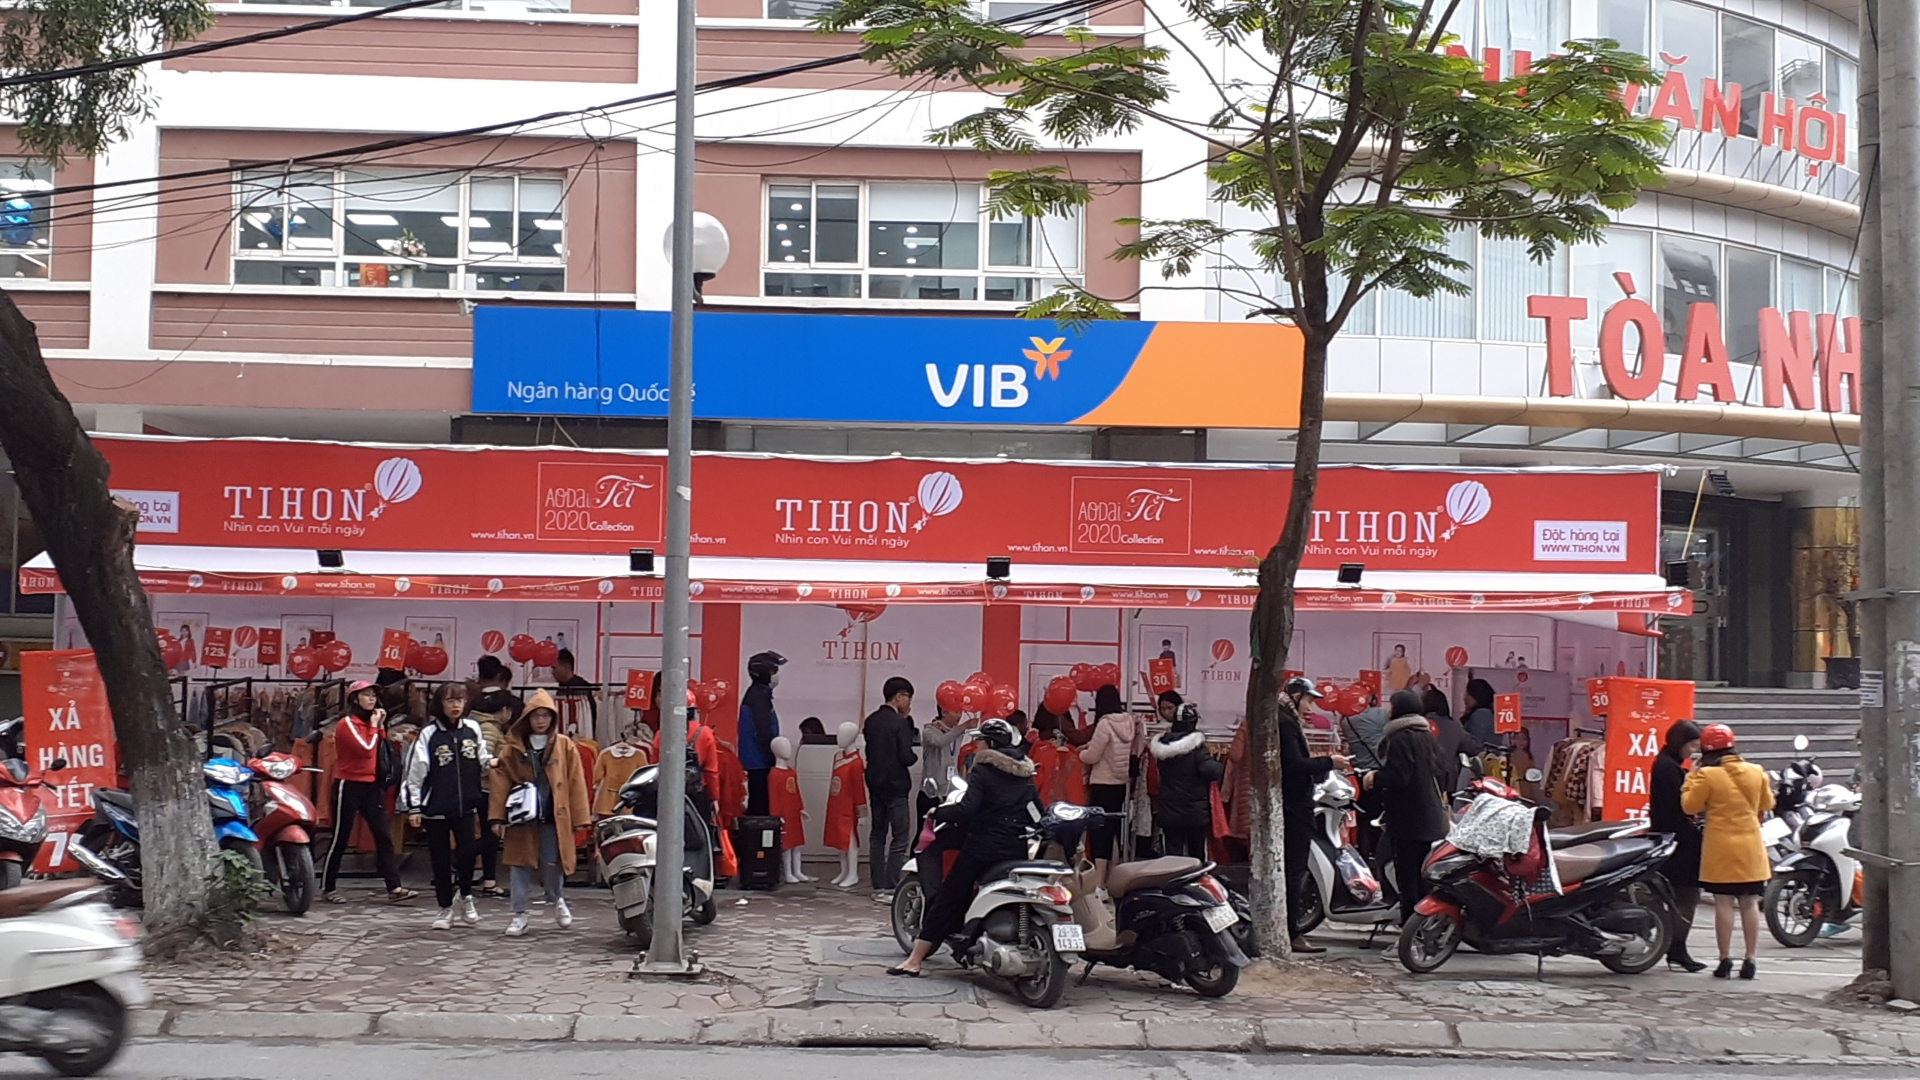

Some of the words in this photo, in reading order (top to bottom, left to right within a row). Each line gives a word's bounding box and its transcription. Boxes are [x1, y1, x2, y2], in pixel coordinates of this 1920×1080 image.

[1760, 91, 1848, 178] HỘI
[1526, 271, 1738, 403] TÒA
[508, 381, 558, 403] Ngân
[565, 381, 613, 405] hàng
[618, 382, 670, 403] Quốc
[924, 362, 1029, 410] VIB
[223, 485, 367, 522] TIHON
[544, 509, 590, 531] 2020
[589, 521, 635, 533] Collection
[775, 498, 911, 534] TIHON
[256, 525, 280, 533] con
[283, 522, 304, 534] Vui
[471, 529, 535, 540] www.tihon.vn
[1077, 523, 1121, 544] 2020
[1120, 533, 1164, 545] Collection
[1310, 510, 1439, 544] TIHON
[775, 533, 803, 544] Nhìn
[806, 536, 829, 545] con
[832, 534, 851, 545] Vui
[1570, 528, 1599, 544] hàng
[1602, 529, 1620, 544] tại
[1007, 542, 1068, 553] www.tihon.vn
[1194, 544, 1255, 556] www.tihon.vn
[1304, 544, 1332, 555] Nhìn
[1335, 546, 1357, 556] con
[1360, 545, 1380, 556] Vui
[1409, 545, 1438, 558] ngày
[1541, 543, 1620, 553] WWW.TIHON.VN
[221, 580, 263, 591] TIHON
[315, 579, 376, 589] www.tihon.vn
[630, 586, 665, 597] TIHO
[917, 586, 975, 596] www.tihon.vn
[828, 588, 869, 599] TIHON
[1112, 589, 1169, 599] www.tihon.vn
[822, 640, 901, 661] TIHON
[1201, 670, 1242, 681] TIHON
[48, 700, 82, 731] XẢ
[1628, 728, 1660, 757] XẢ
[39, 742, 105, 771] HÀNG
[1615, 766, 1652, 795] HÀ
